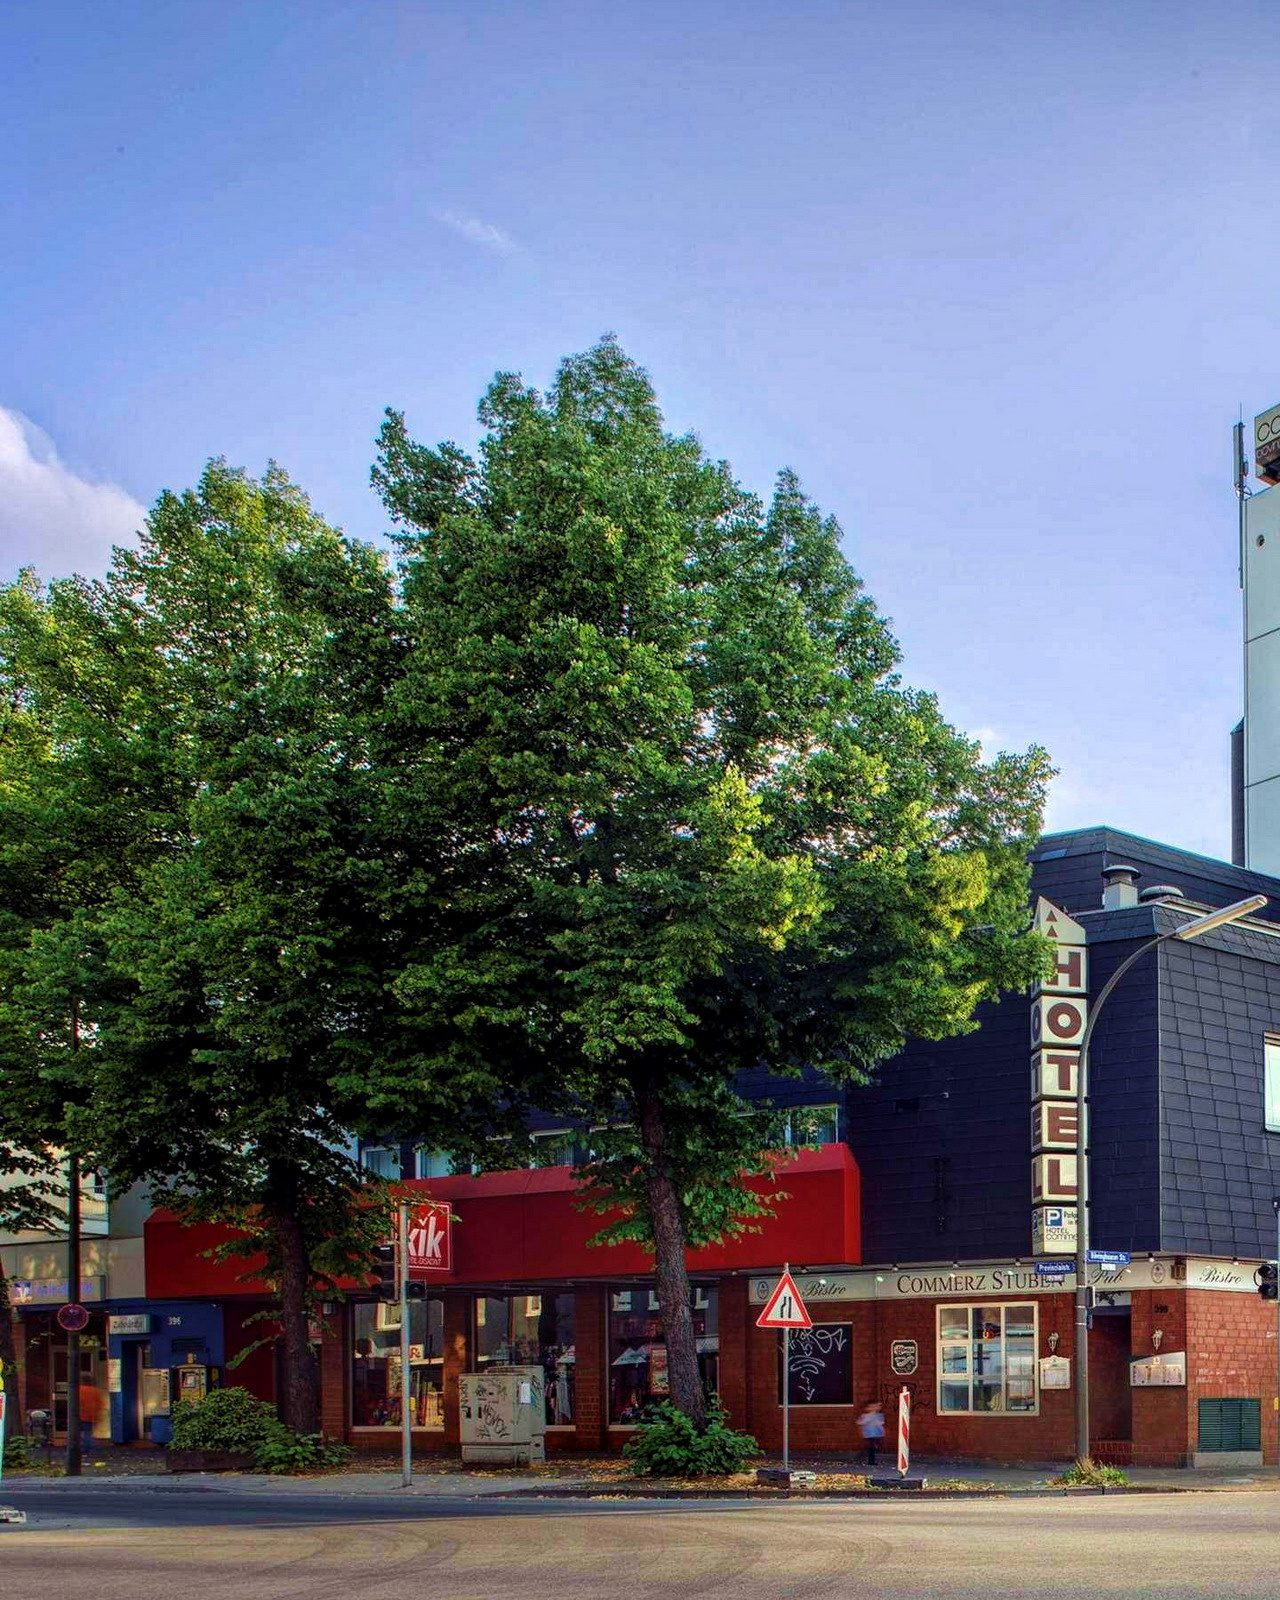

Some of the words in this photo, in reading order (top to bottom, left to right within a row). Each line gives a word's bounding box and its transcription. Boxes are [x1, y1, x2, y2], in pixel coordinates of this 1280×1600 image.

[1046, 951, 1082, 1196] HOTEL
[802, 1280, 847, 1297] Bistro
[1088, 1266, 1126, 1285] Pub
[1199, 1264, 1243, 1284] Bistro
